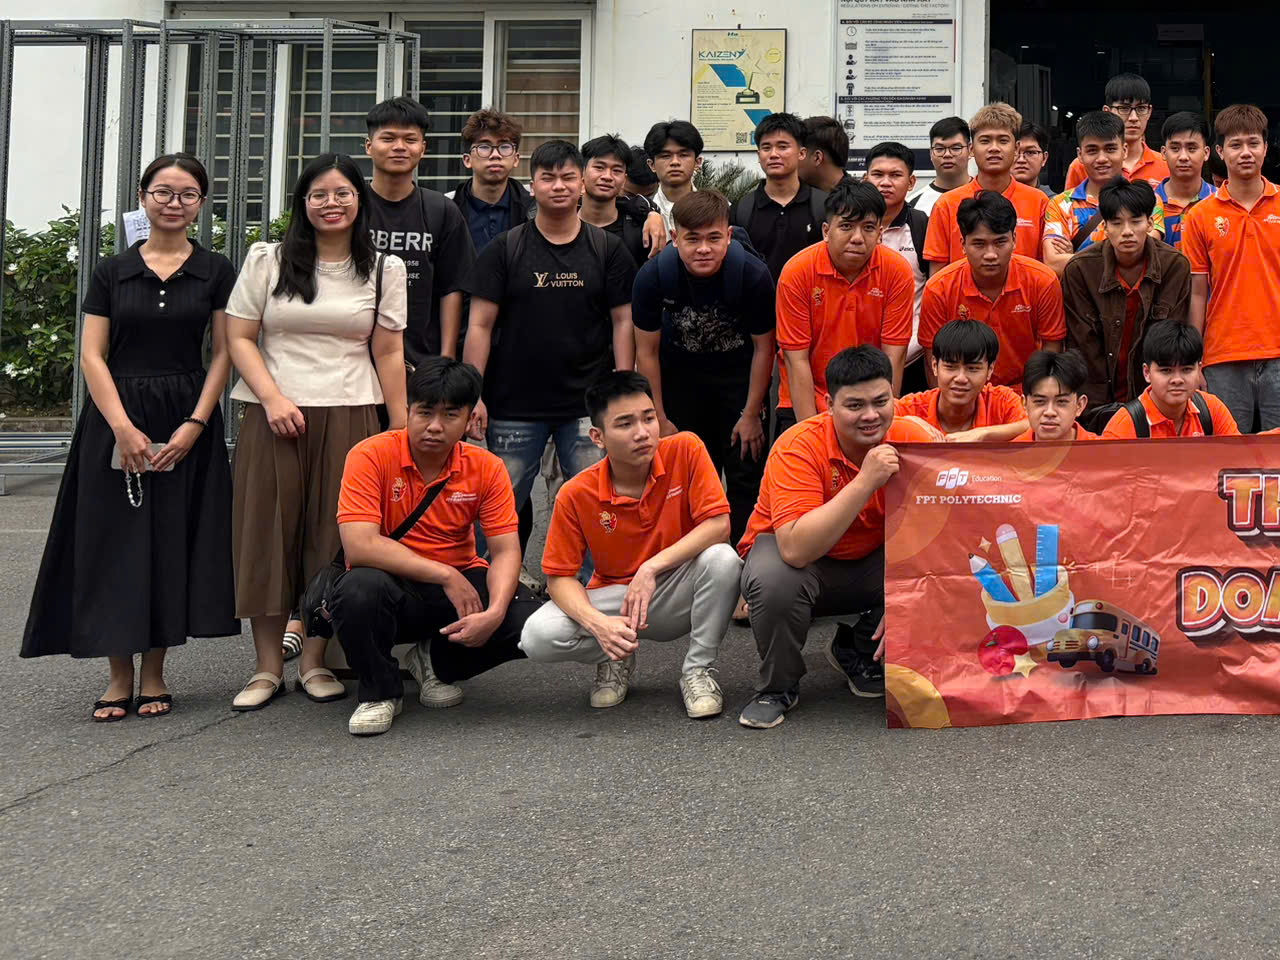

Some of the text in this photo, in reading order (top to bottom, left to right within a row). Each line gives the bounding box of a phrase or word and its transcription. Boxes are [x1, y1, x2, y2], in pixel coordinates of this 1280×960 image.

[698, 50, 737, 58] KAIZEN
[550, 279, 584, 288] VUITTON
[936, 467, 1002, 489] FPT Education
[916, 494, 1022, 504] FPT POLYTECHNIC
